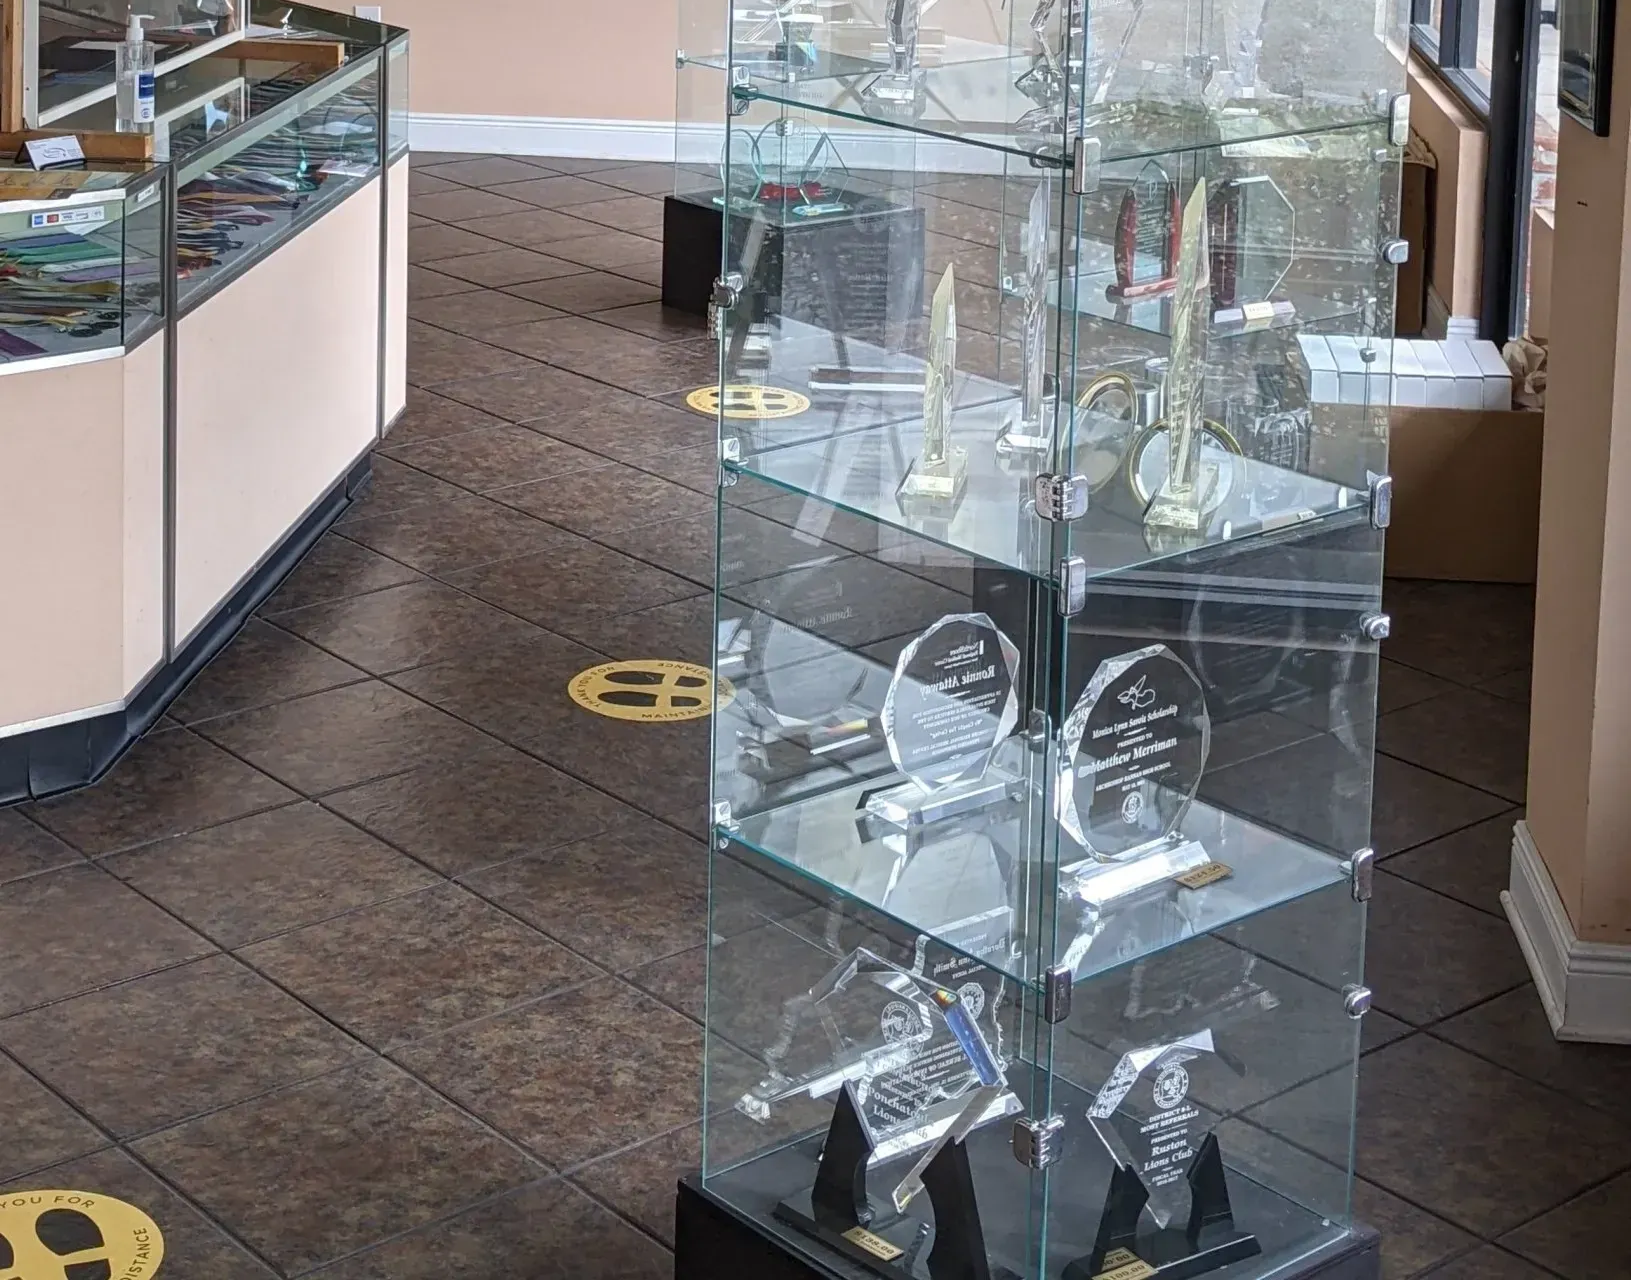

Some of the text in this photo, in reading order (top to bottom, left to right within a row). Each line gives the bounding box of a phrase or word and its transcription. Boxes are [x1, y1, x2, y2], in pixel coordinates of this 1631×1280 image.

[1092, 725, 1113, 740] Monica
[1147, 704, 1178, 722] Scholarship
[1132, 737, 1178, 760] Merriman
[1160, 1109, 1199, 1127] REFERRALS
[1150, 1131, 1180, 1145] PRESENTED
[1151, 1139, 1187, 1157] Ruston
[1144, 1147, 1193, 1172] Lions Club
[54, 1195, 95, 1209] FOR
